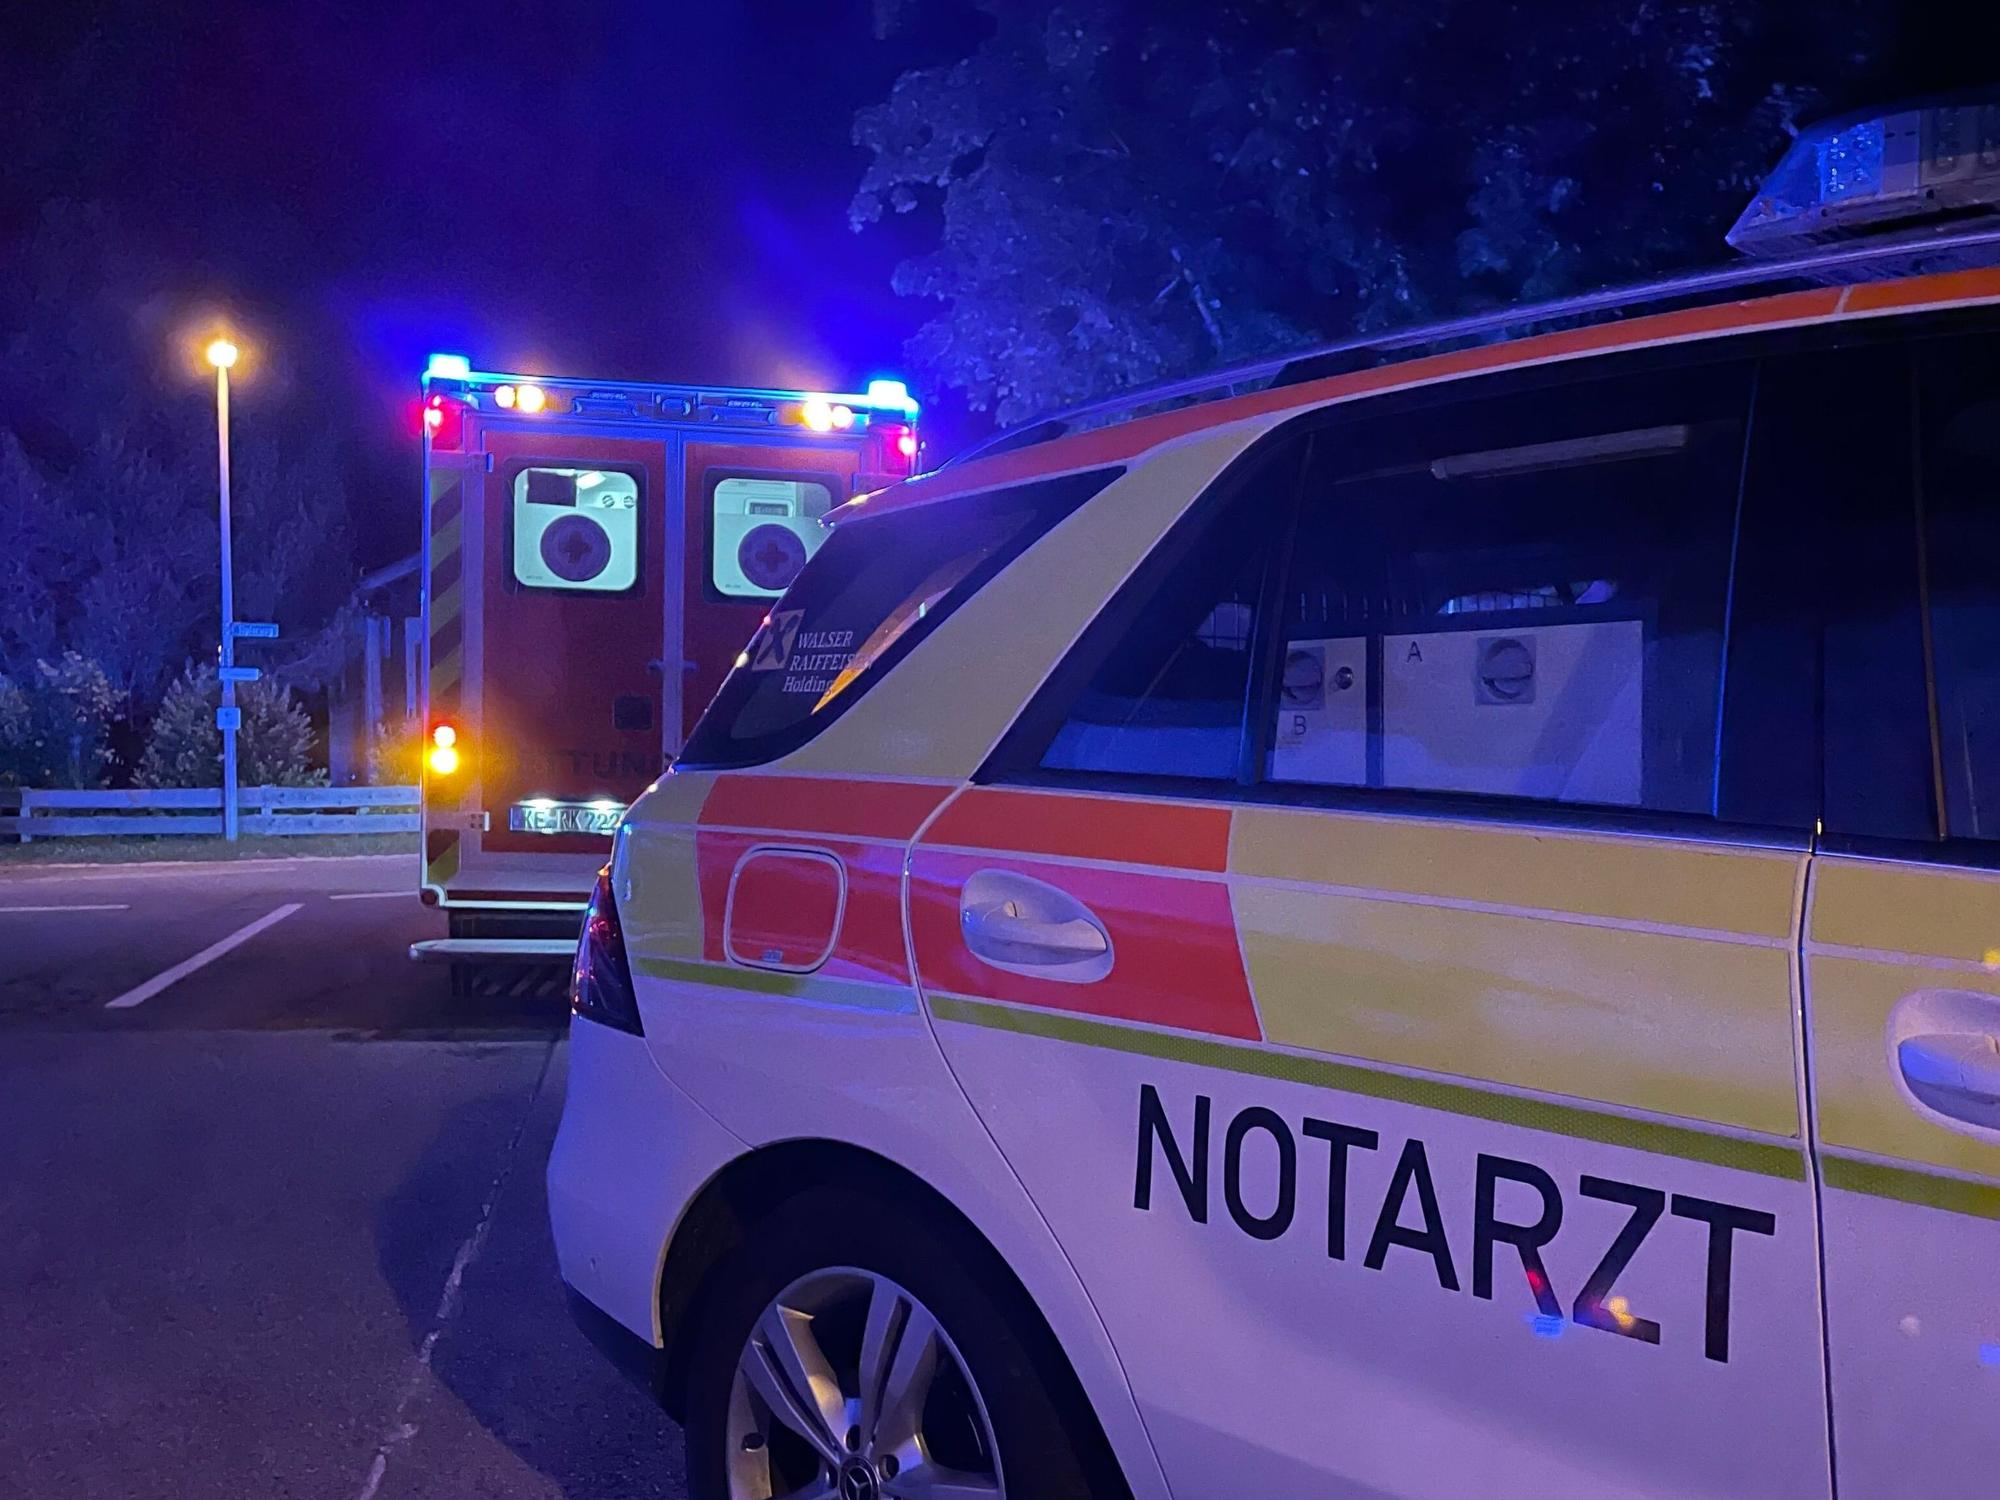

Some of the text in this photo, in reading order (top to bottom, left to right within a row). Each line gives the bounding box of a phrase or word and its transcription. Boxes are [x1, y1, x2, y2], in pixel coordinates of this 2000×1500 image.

[798, 631, 854, 649] WALSER
[1406, 641, 1423, 663] A
[1293, 715, 1307, 735] B
[1134, 1083, 1775, 1364] NOTARZT
